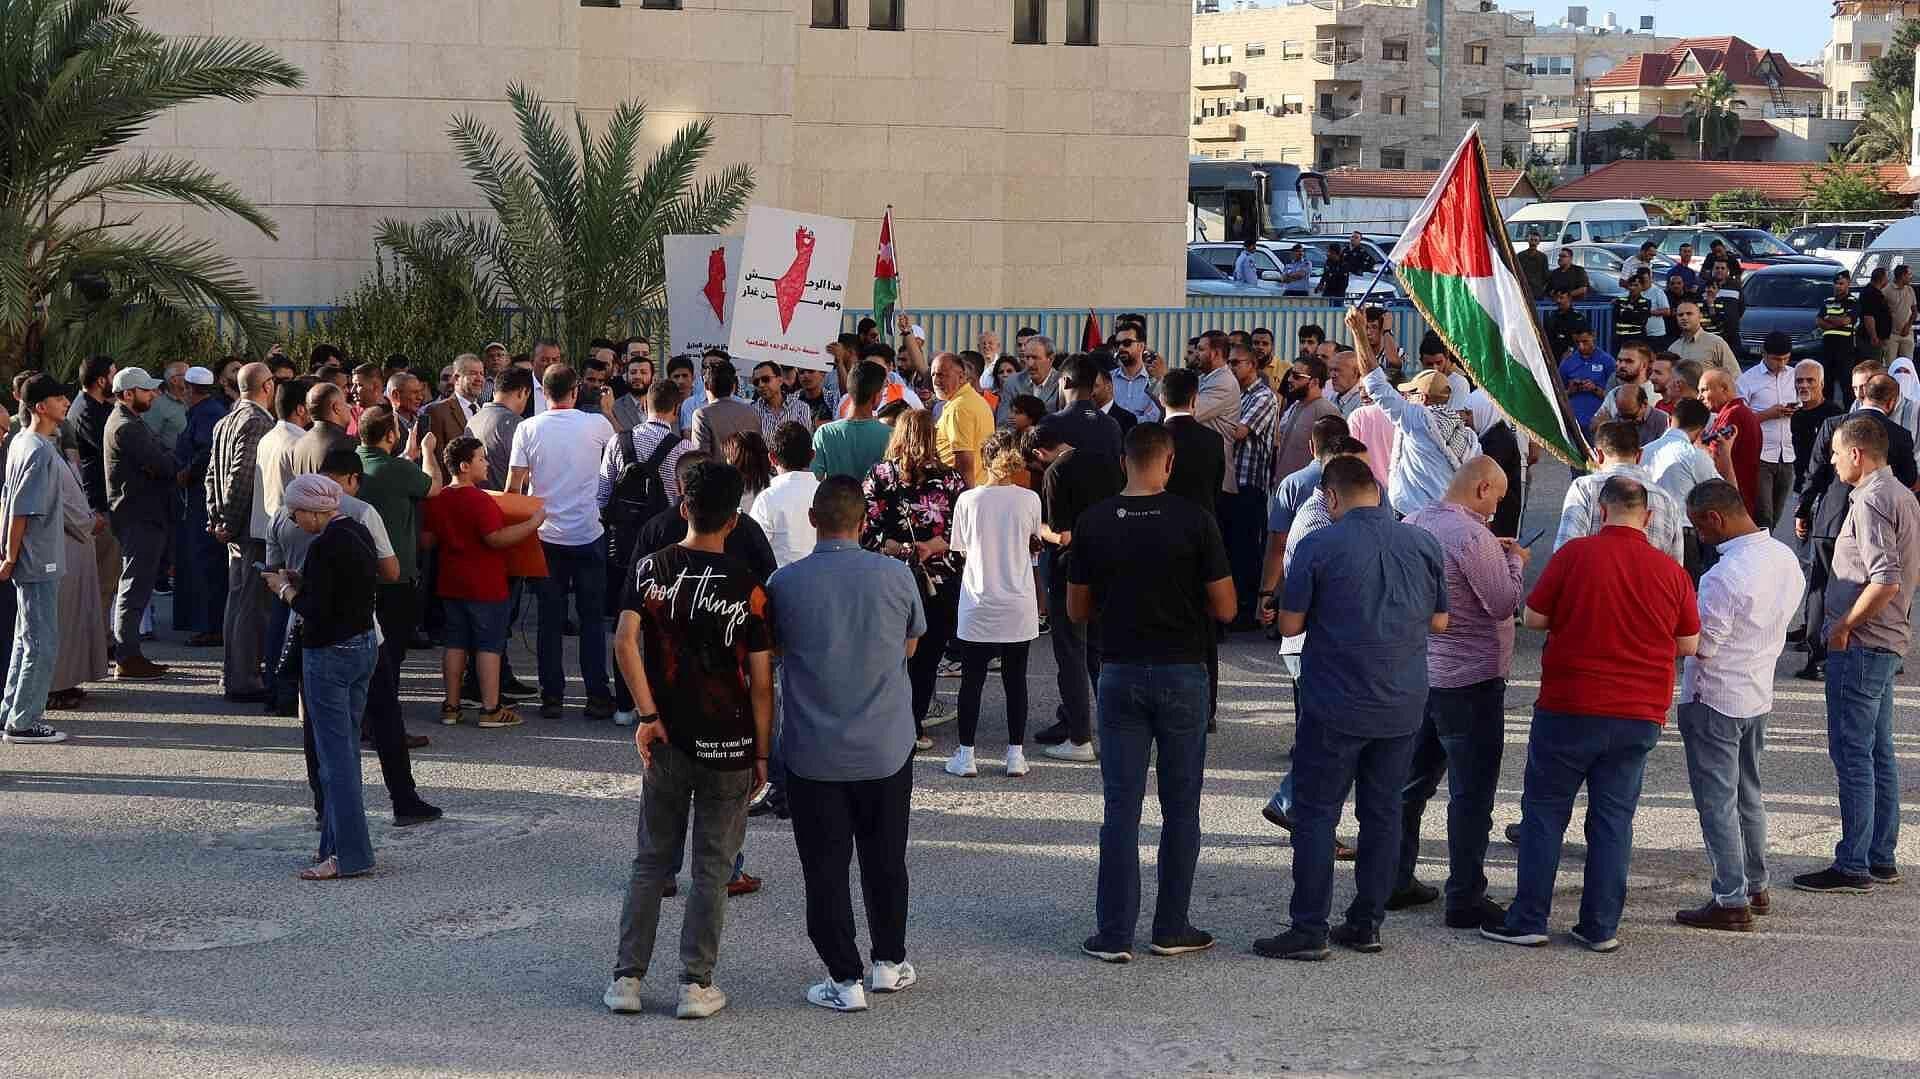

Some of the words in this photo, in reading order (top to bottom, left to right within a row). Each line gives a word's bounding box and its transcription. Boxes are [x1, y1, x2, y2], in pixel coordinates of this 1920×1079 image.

[636, 558, 688, 620] Good
[695, 740, 720, 749] Never
[696, 750, 727, 759] comfort
